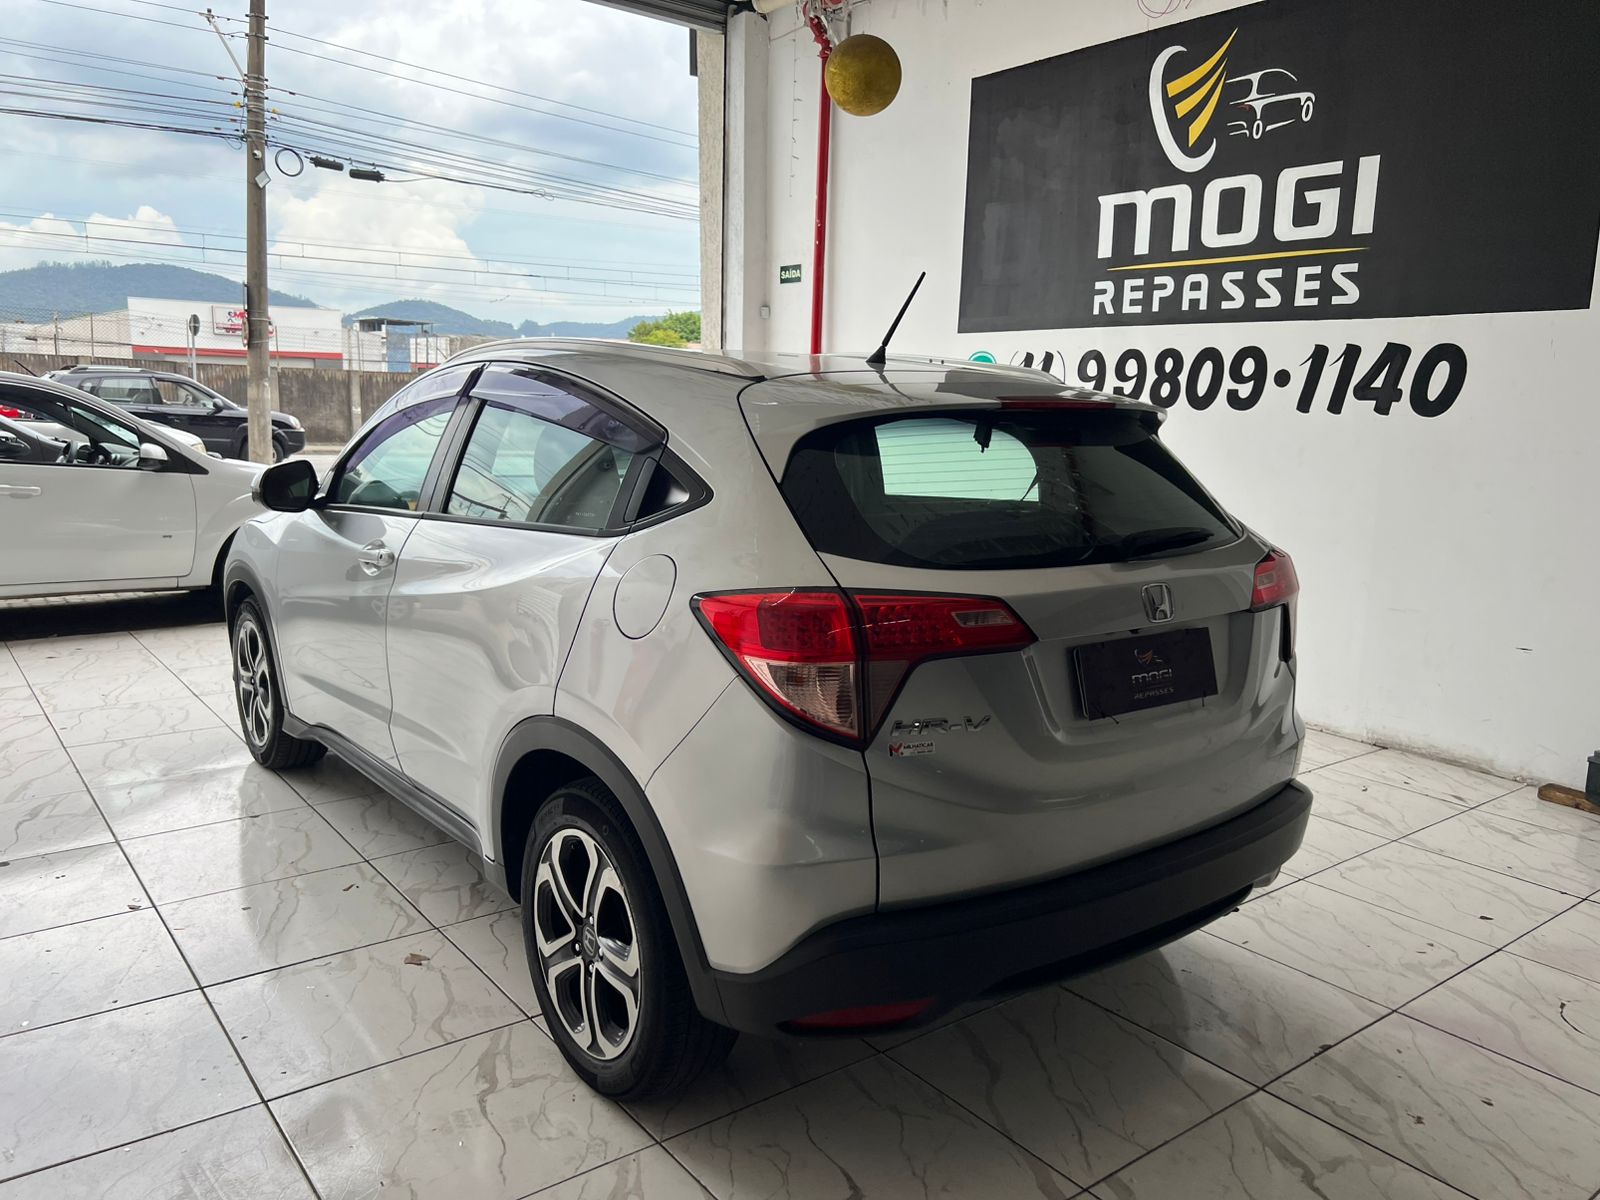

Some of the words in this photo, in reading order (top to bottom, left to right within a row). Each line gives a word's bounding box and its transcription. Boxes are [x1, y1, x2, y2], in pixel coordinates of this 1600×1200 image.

[1097, 154, 1381, 259] MOGI
[780, 268, 801, 279] SAÍDA
[1092, 262, 1361, 315] REPASSES
[890, 714, 992, 737] HR-V
